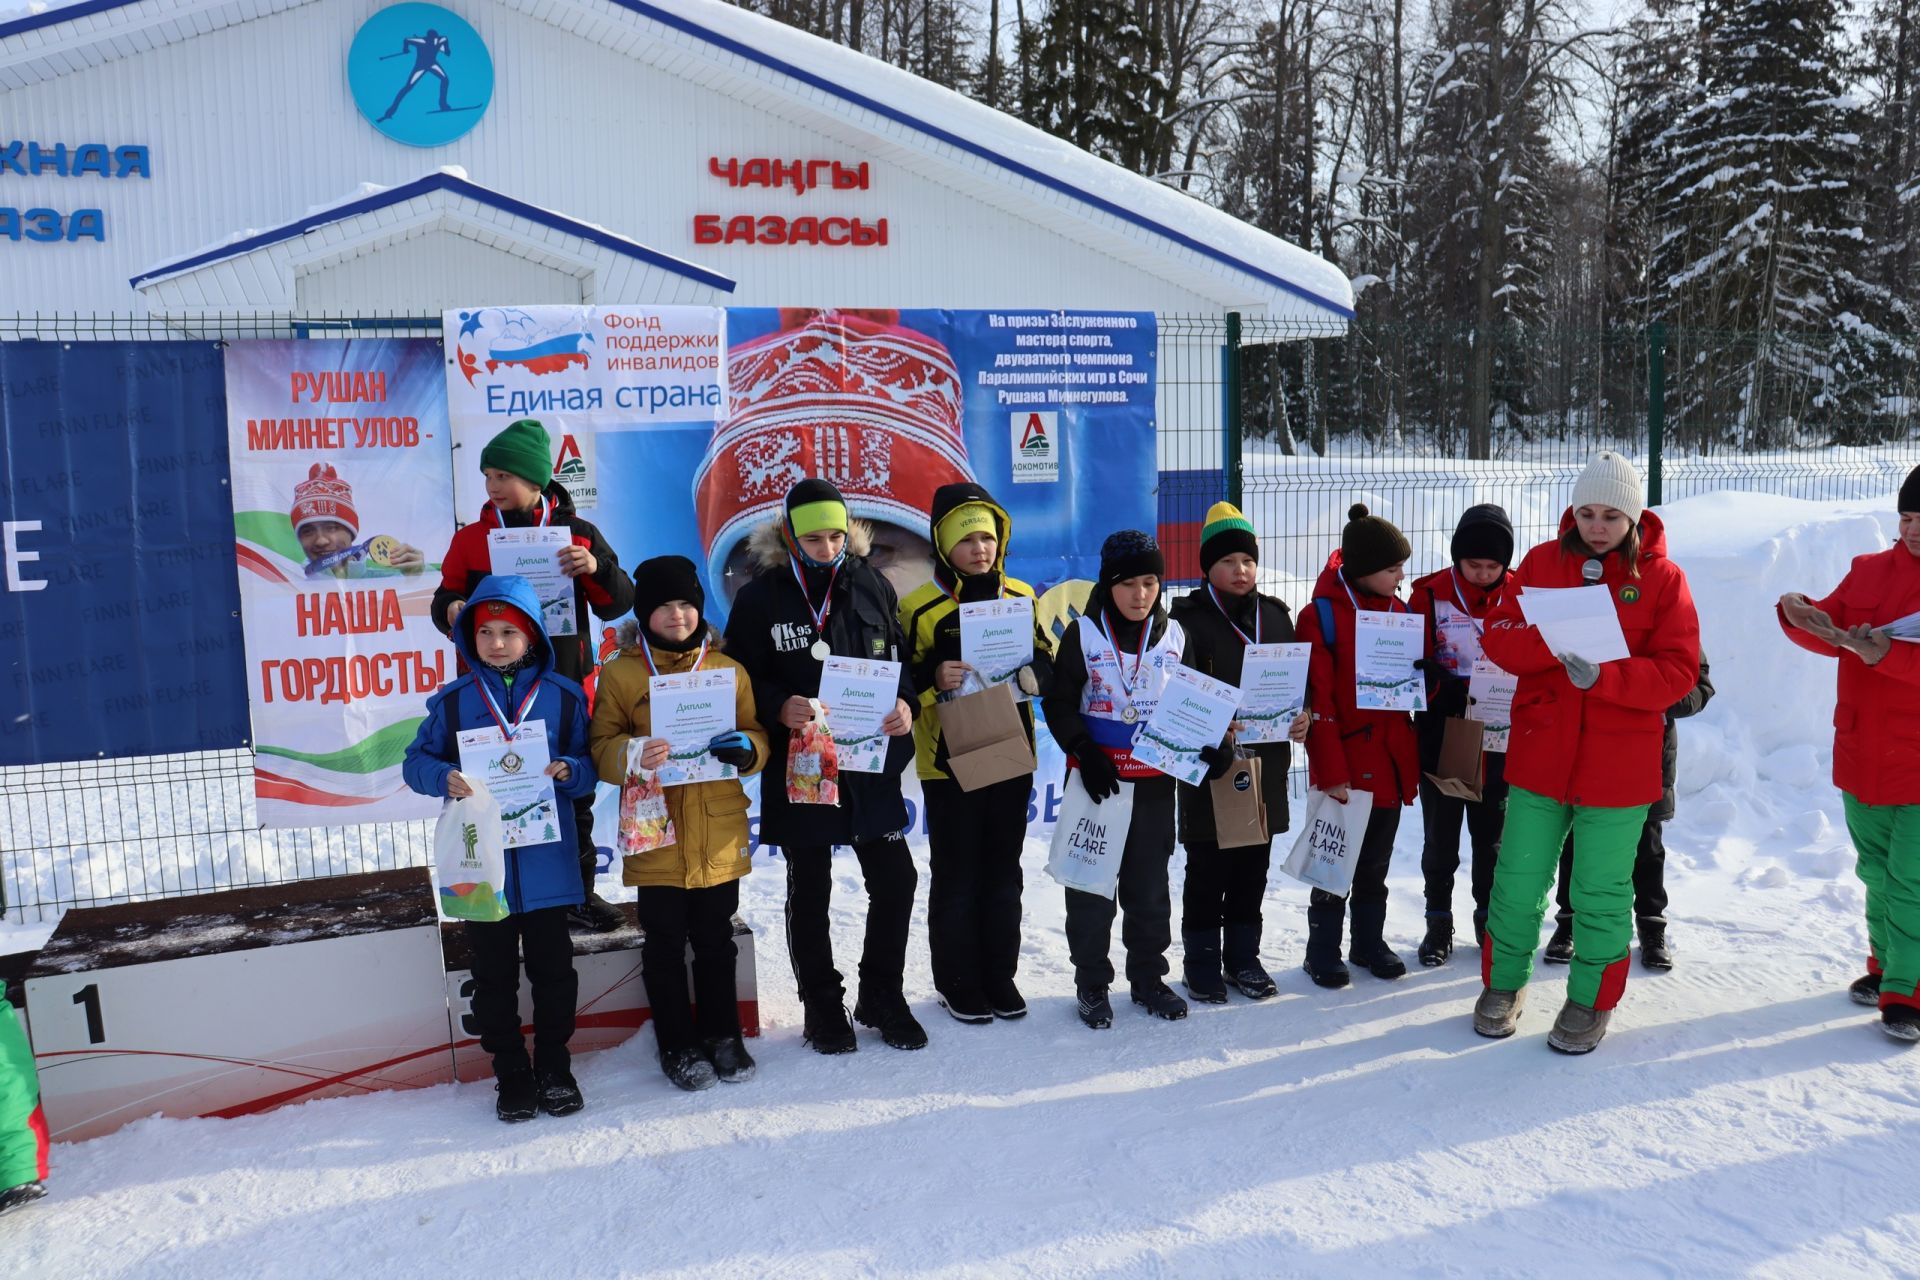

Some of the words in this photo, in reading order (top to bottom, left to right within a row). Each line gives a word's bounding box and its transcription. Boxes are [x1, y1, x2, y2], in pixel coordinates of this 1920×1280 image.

[708, 157, 869, 196] ЧАҢГЫ
[693, 214, 888, 246] БАЗАСЫ
[604, 313, 661, 332] Фонд
[989, 314, 1007, 328] На
[1007, 315, 1049, 329] призы
[1051, 313, 1137, 329] Заслуженного
[606, 334, 719, 353] поддержки
[1016, 334, 1067, 348] мастера
[1069, 334, 1113, 348] спорта,
[607, 354, 720, 372] инвалидов
[995, 353, 1070, 367] двукратного
[1073, 353, 1133, 366] чемпиона
[979, 370, 1086, 386] Паралимпийских
[1087, 372, 1107, 386] игр
[1108, 373, 1117, 384] в
[1118, 370, 1148, 384] Сочи
[291, 371, 387, 403] РУШАН
[487, 384, 602, 416] Единая
[616, 383, 721, 414] страна
[998, 389, 1046, 405] Рушана
[1047, 389, 1129, 404] Миннегулова.
[247, 416, 420, 451] МИННЕГУЛОВ
[1012, 462, 1059, 472] ЛОКОМОТИВ
[569, 487, 598, 497] МОТИВ
[515, 556, 549, 568] Диплом
[295, 588, 404, 637] НАША
[796, 624, 812, 636] 95
[982, 628, 1013, 640] Диплом
[781, 636, 809, 652] CLUB
[1375, 637, 1404, 647] Диплом
[261, 648, 446, 705] ГОРДОСТЬ!
[842, 687, 875, 698] Диплом
[1489, 684, 1515, 694] Дипло
[676, 702, 712, 714] Диплом
[1131, 699, 1159, 707] Детско
[1076, 817, 1106, 839] FINN
[1315, 819, 1346, 842] FINN
[1068, 832, 1108, 855] FLARE
[73, 983, 106, 1045] 1
